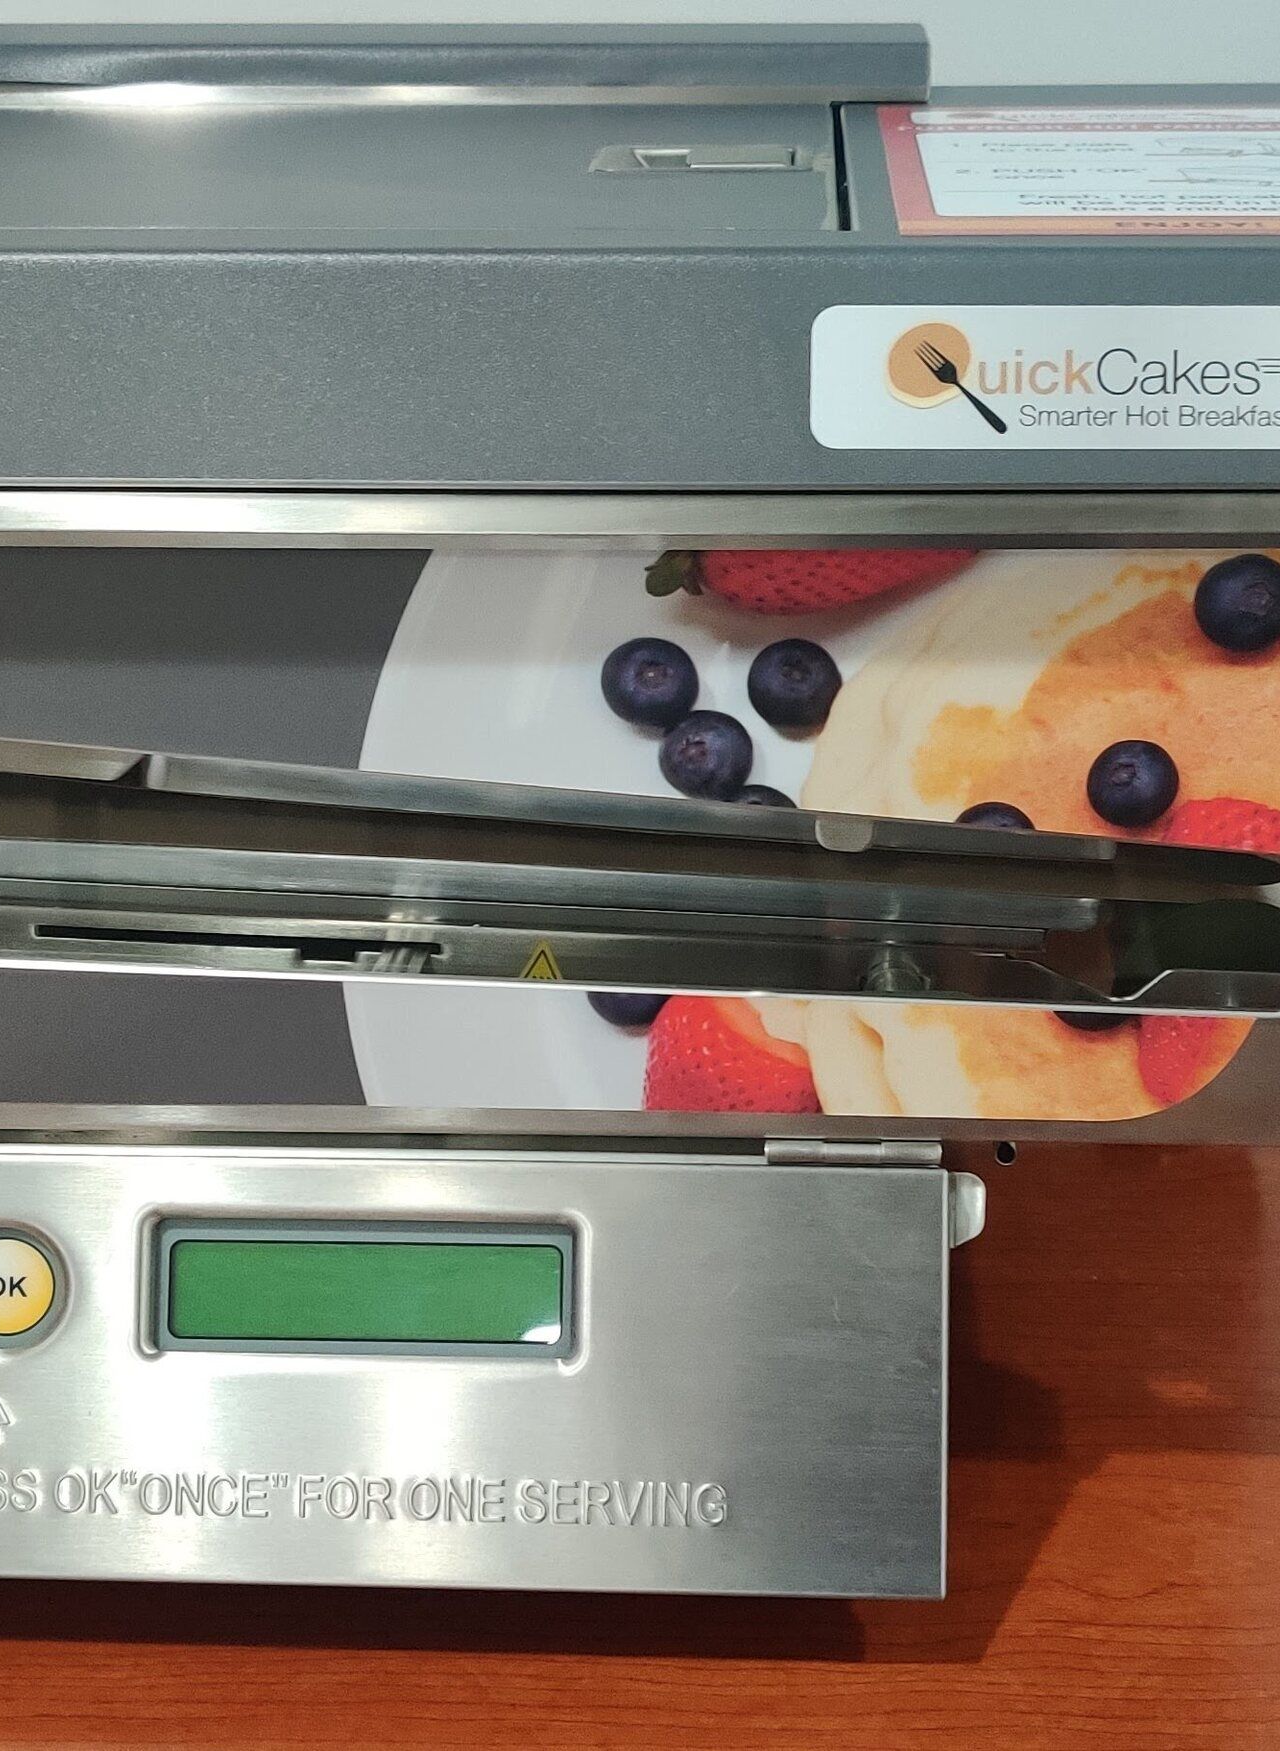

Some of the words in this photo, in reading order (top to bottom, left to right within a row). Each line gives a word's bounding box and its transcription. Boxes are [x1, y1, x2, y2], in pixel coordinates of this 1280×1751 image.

[1114, 221, 1266, 229] ENJOY!
[1019, 404, 1117, 428] Smarter
[1125, 404, 1171, 428] Hot
[296, 1475, 397, 1521] FOR
[407, 1477, 507, 1523] ONE
[517, 1479, 729, 1528] SERVING
